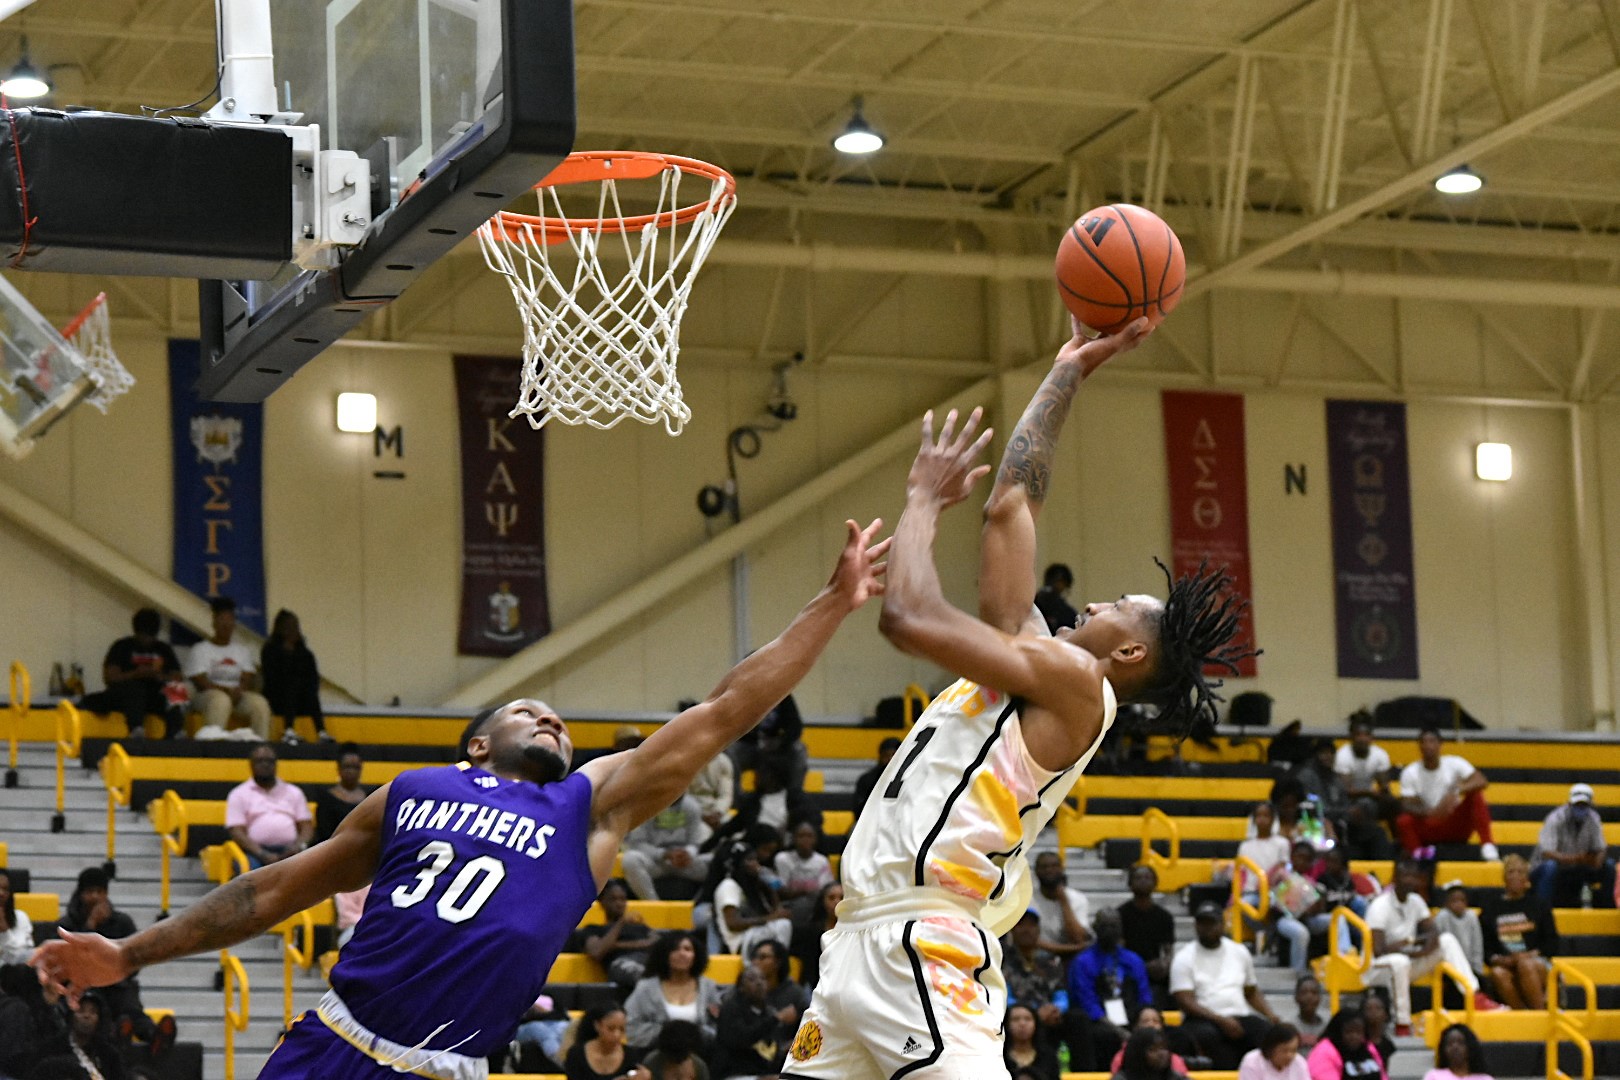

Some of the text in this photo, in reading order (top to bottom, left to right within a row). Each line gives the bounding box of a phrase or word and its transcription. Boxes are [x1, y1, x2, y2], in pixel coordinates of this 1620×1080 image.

[373, 424, 405, 458] M
[1284, 463, 1307, 495] N
[883, 726, 937, 799] 1
[395, 797, 557, 860] PANTHERS
[390, 839, 506, 925] 30
